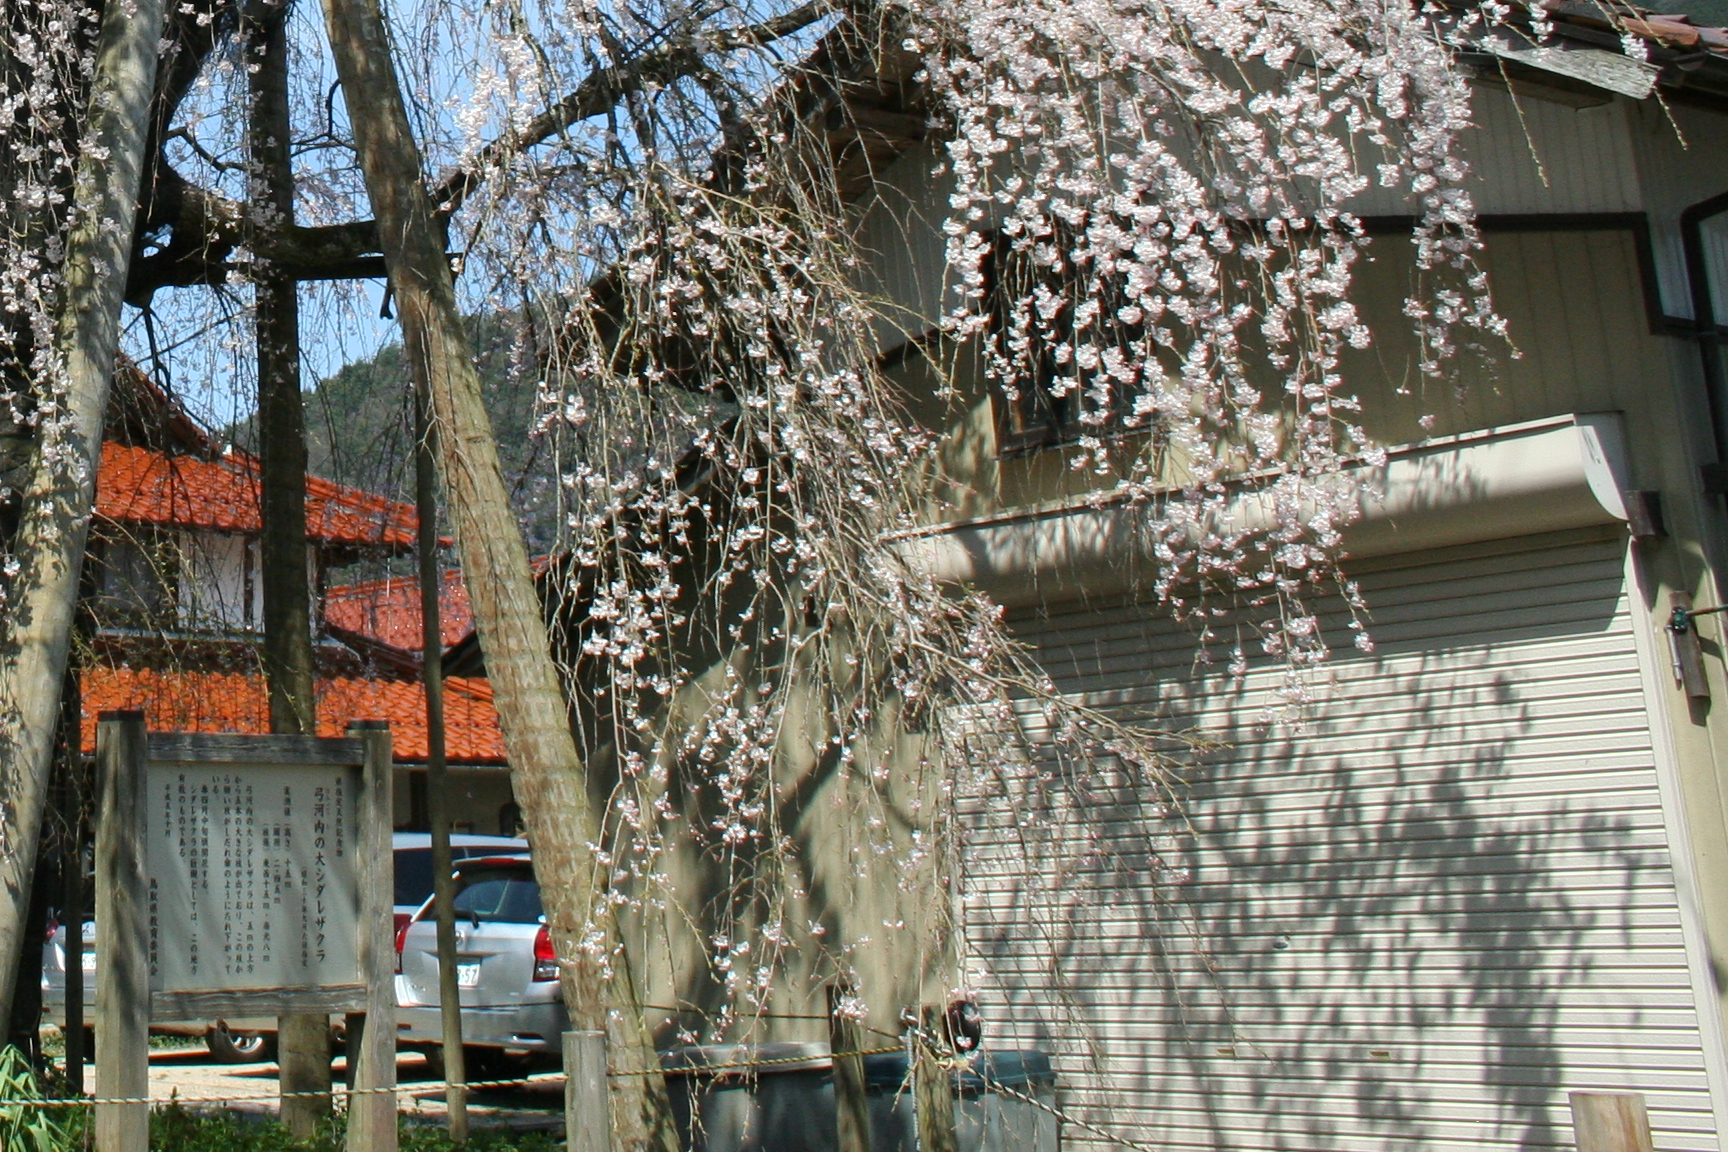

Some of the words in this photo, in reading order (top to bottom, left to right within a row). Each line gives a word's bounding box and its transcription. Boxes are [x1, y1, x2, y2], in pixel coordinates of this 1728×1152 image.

[212, 775, 220, 800] いる。
[314, 786, 326, 962] 弓河内の大シダレザクラ
[149, 877, 158, 976] 鳥取県教育委員会
